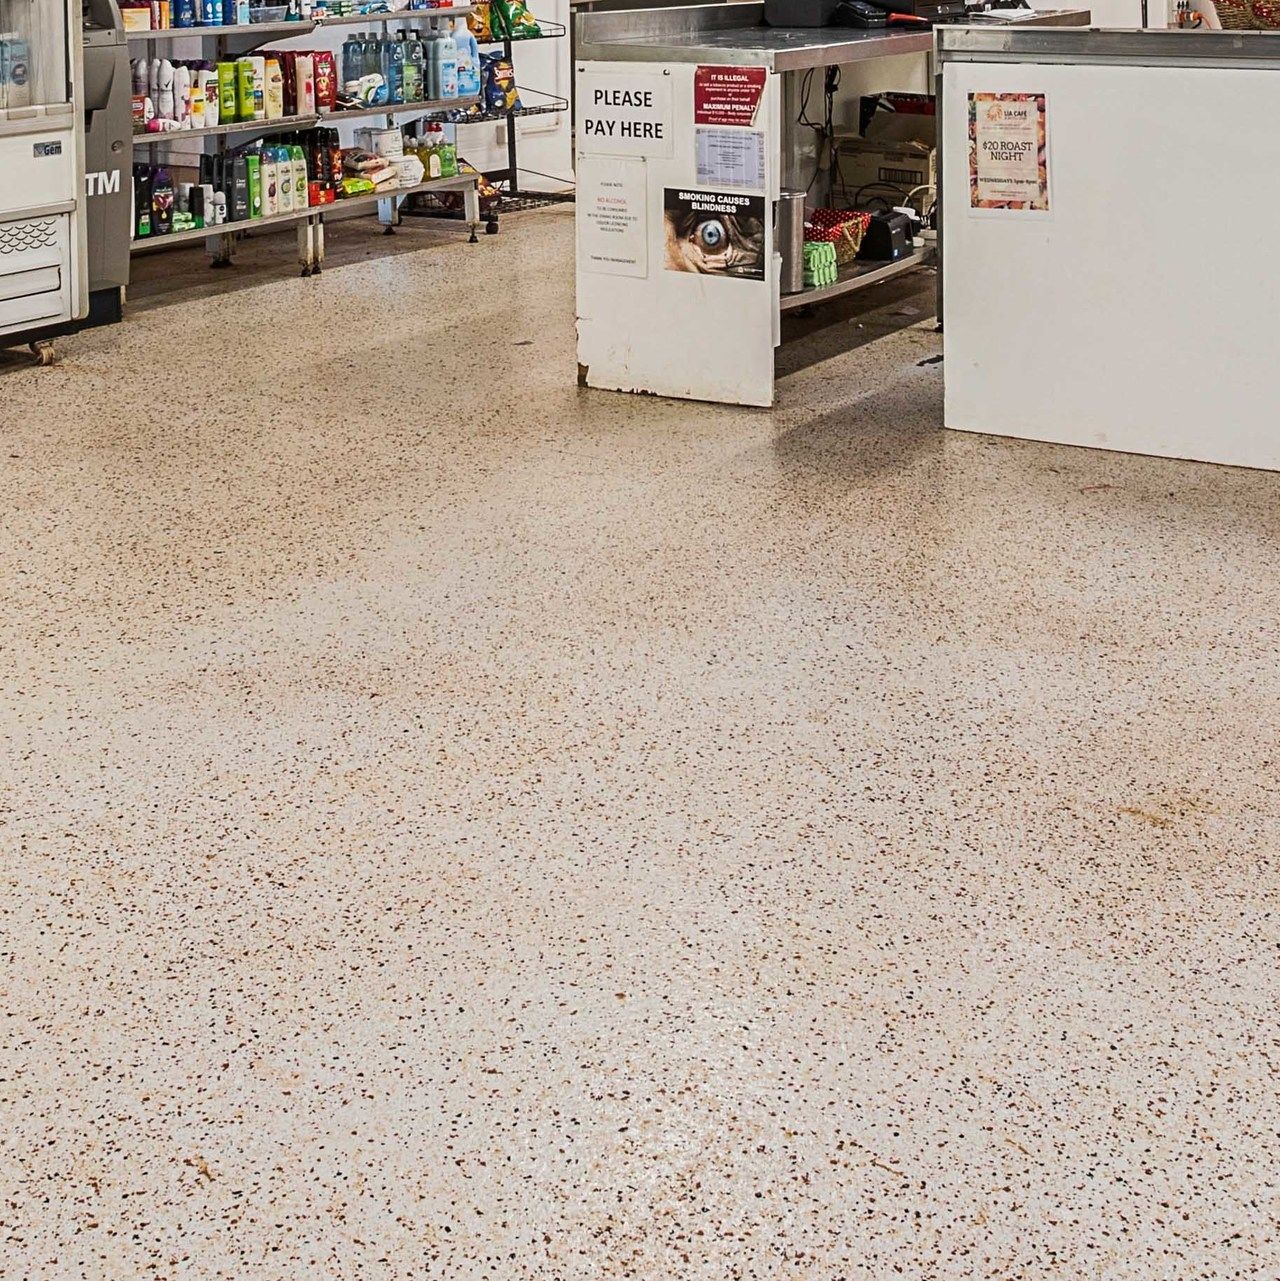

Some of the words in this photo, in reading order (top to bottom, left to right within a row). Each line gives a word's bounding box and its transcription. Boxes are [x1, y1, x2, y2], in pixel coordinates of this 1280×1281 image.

[724, 74, 750, 82] ILLEGAL
[594, 89, 652, 108] PLEASE
[585, 119, 616, 136] PAY
[621, 121, 663, 139] HERE
[43, 143, 62, 156] Gem
[982, 140, 999, 151] $20
[1000, 141, 1033, 152] ROAST
[990, 151, 1024, 161] NIGHT
[84, 169, 120, 197] TM
[678, 191, 716, 203] SMOKING
[717, 195, 751, 207] CAUSES
[691, 201, 738, 214] BLINDNESS
